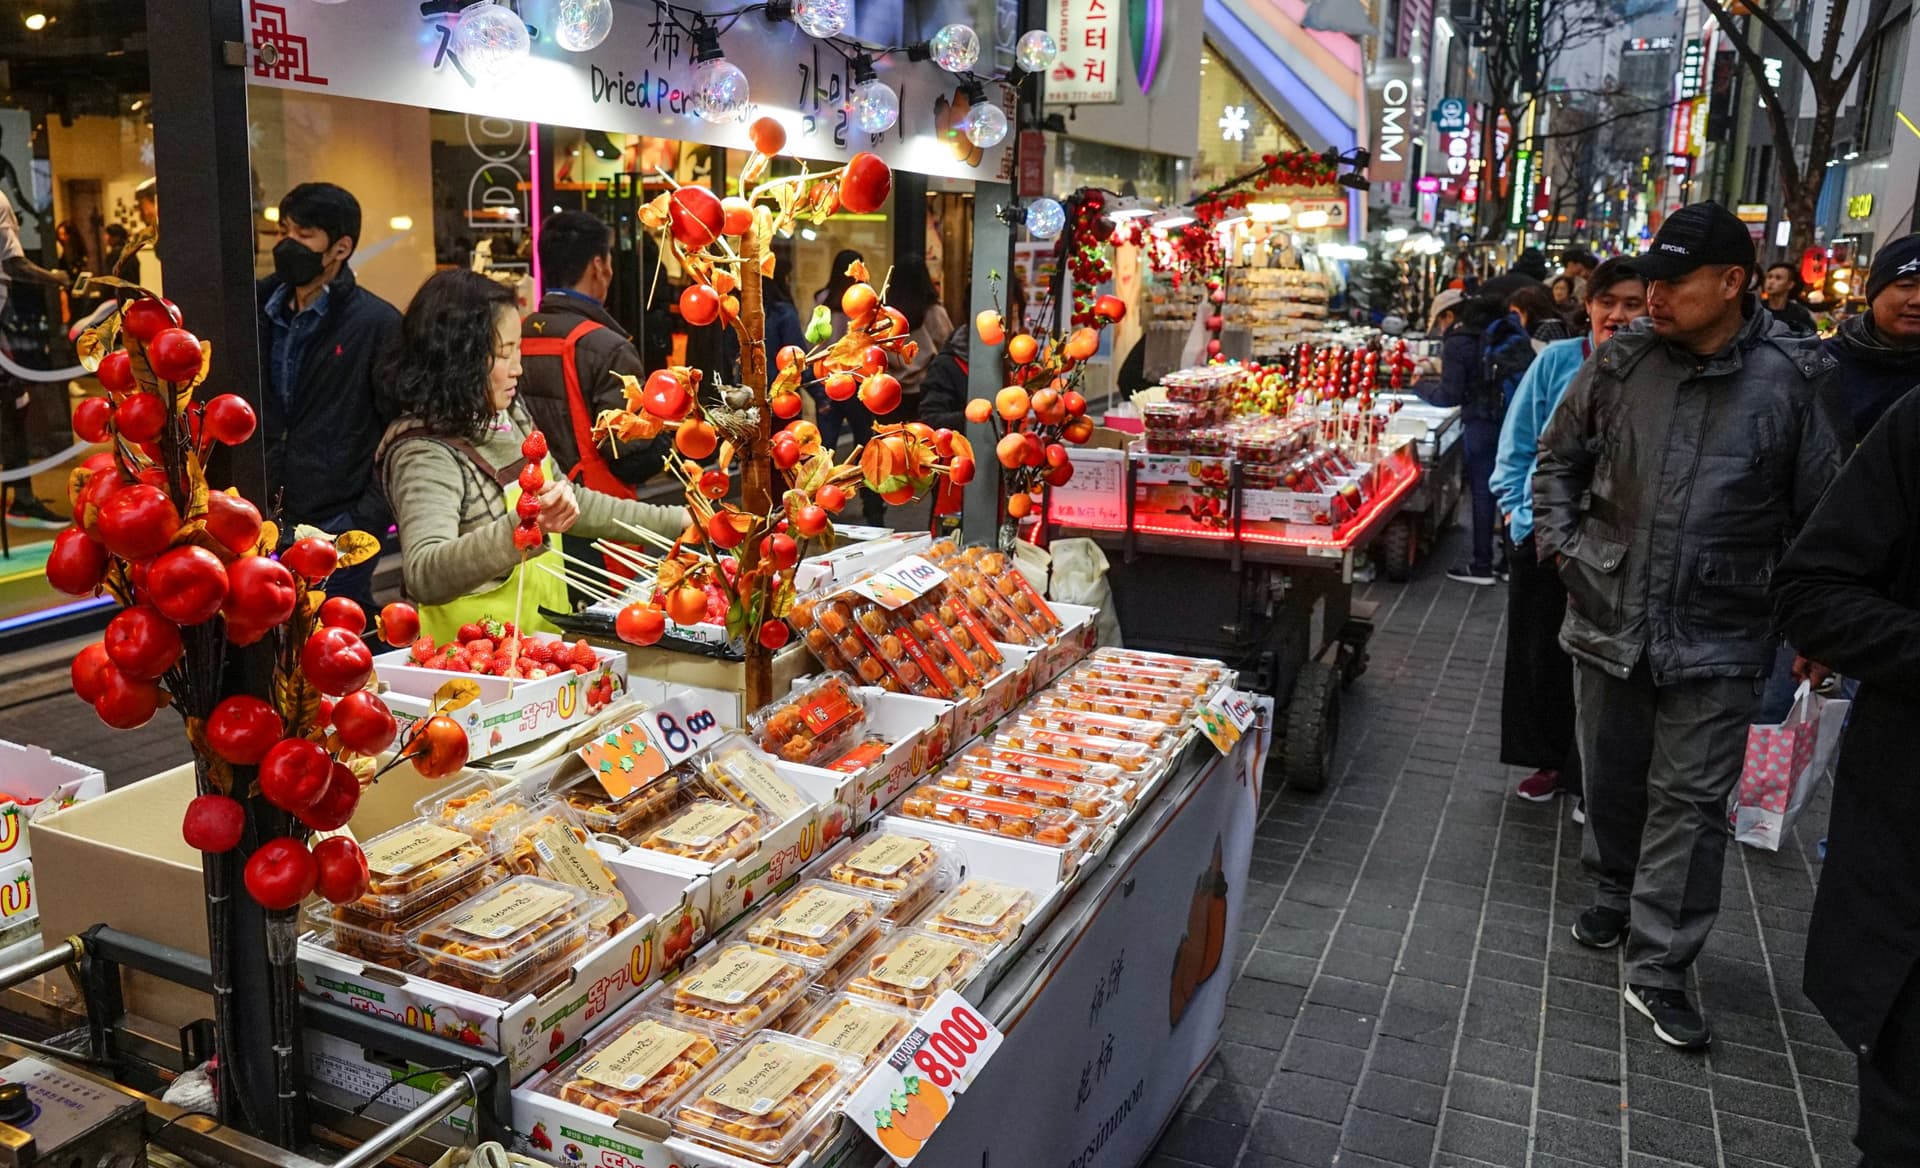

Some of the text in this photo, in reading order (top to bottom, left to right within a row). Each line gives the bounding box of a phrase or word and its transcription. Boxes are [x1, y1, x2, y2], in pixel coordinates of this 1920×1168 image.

[591, 64, 651, 108] Dried
[1380, 79, 1407, 161] OMM
[656, 709, 716, 753] 8,000
[913, 1006, 988, 1087] 8,000
